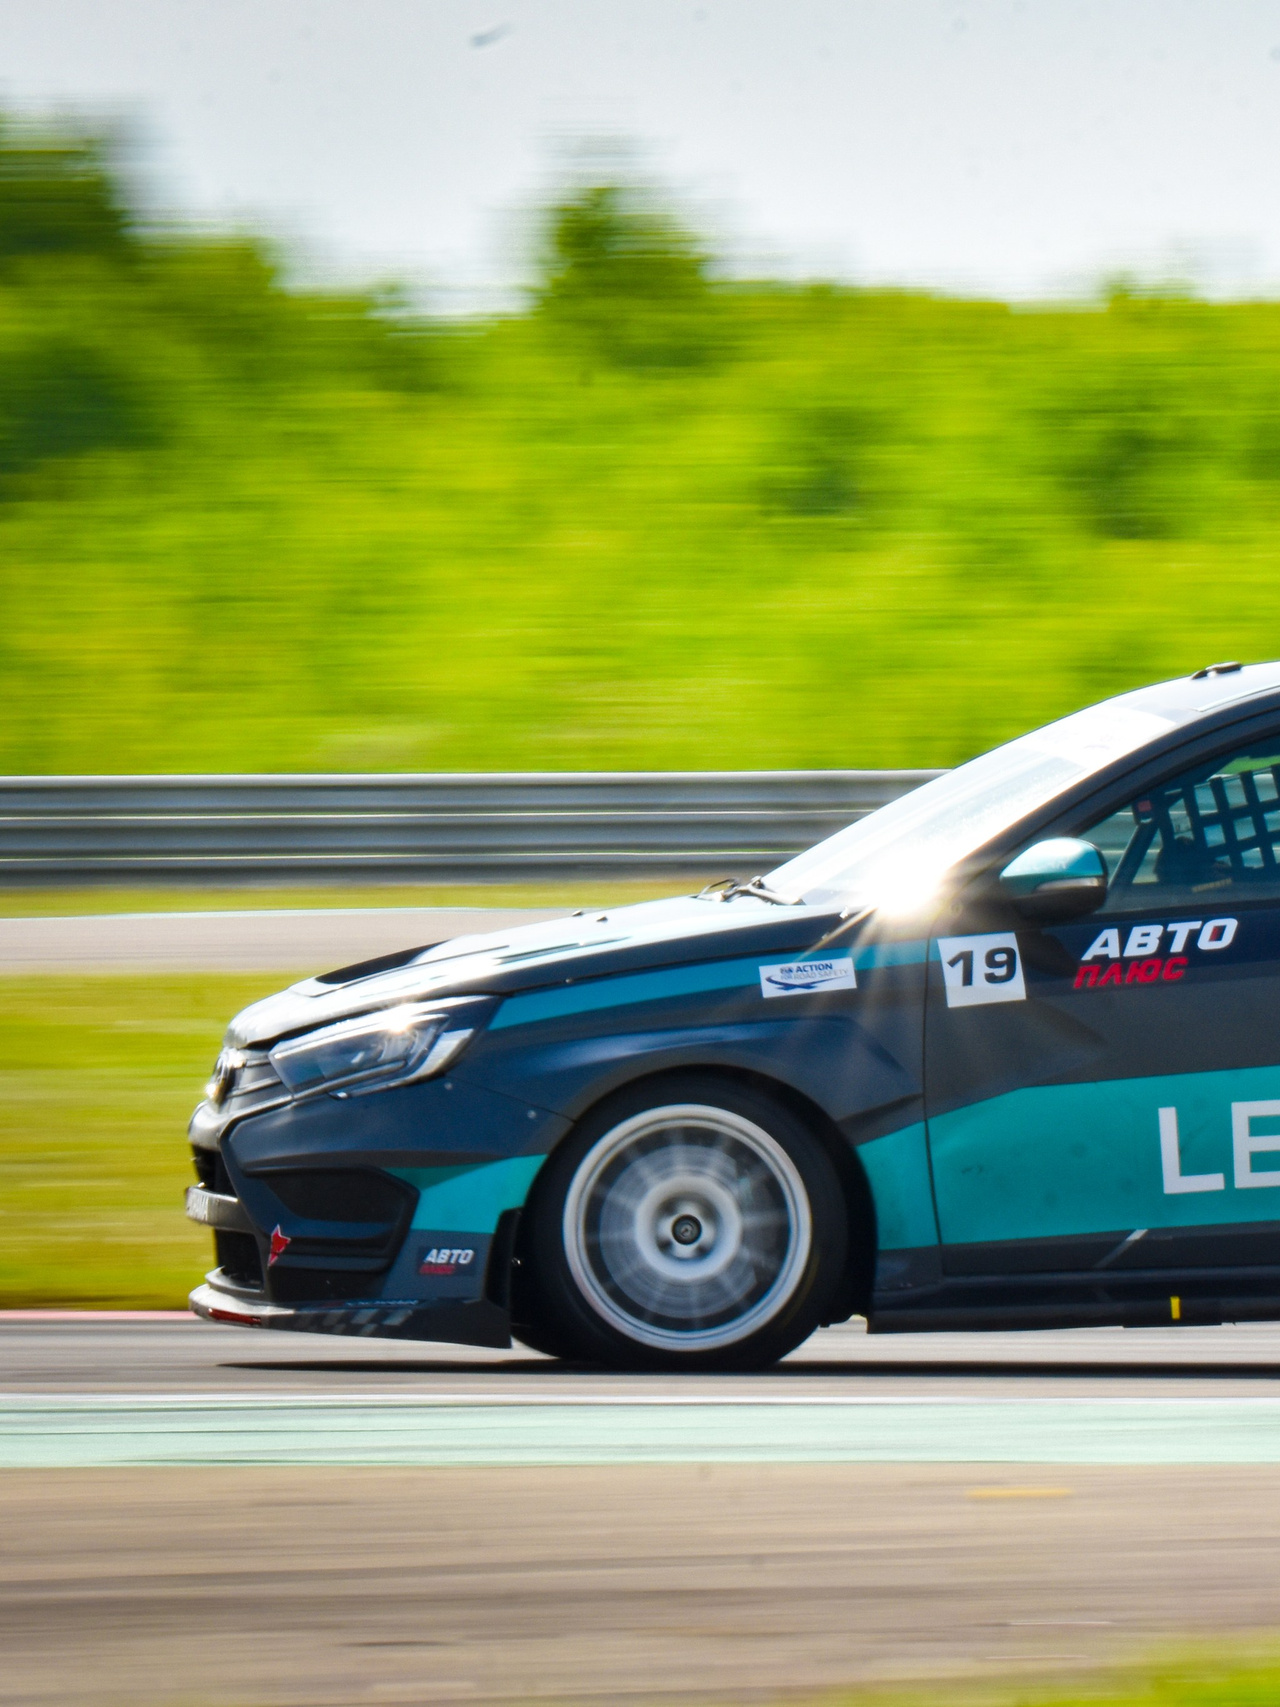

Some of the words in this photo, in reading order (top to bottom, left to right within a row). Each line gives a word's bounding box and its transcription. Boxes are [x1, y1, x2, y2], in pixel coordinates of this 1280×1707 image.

[1080, 917, 1239, 961] АВТО
[794, 971, 817, 980] ROAD
[819, 968, 849, 978] SAFETY
[796, 962, 833, 974] ACTION
[946, 946, 1017, 987] 19
[1072, 956, 1189, 989] ПЛЮС
[423, 1248, 475, 1265] АВТО
